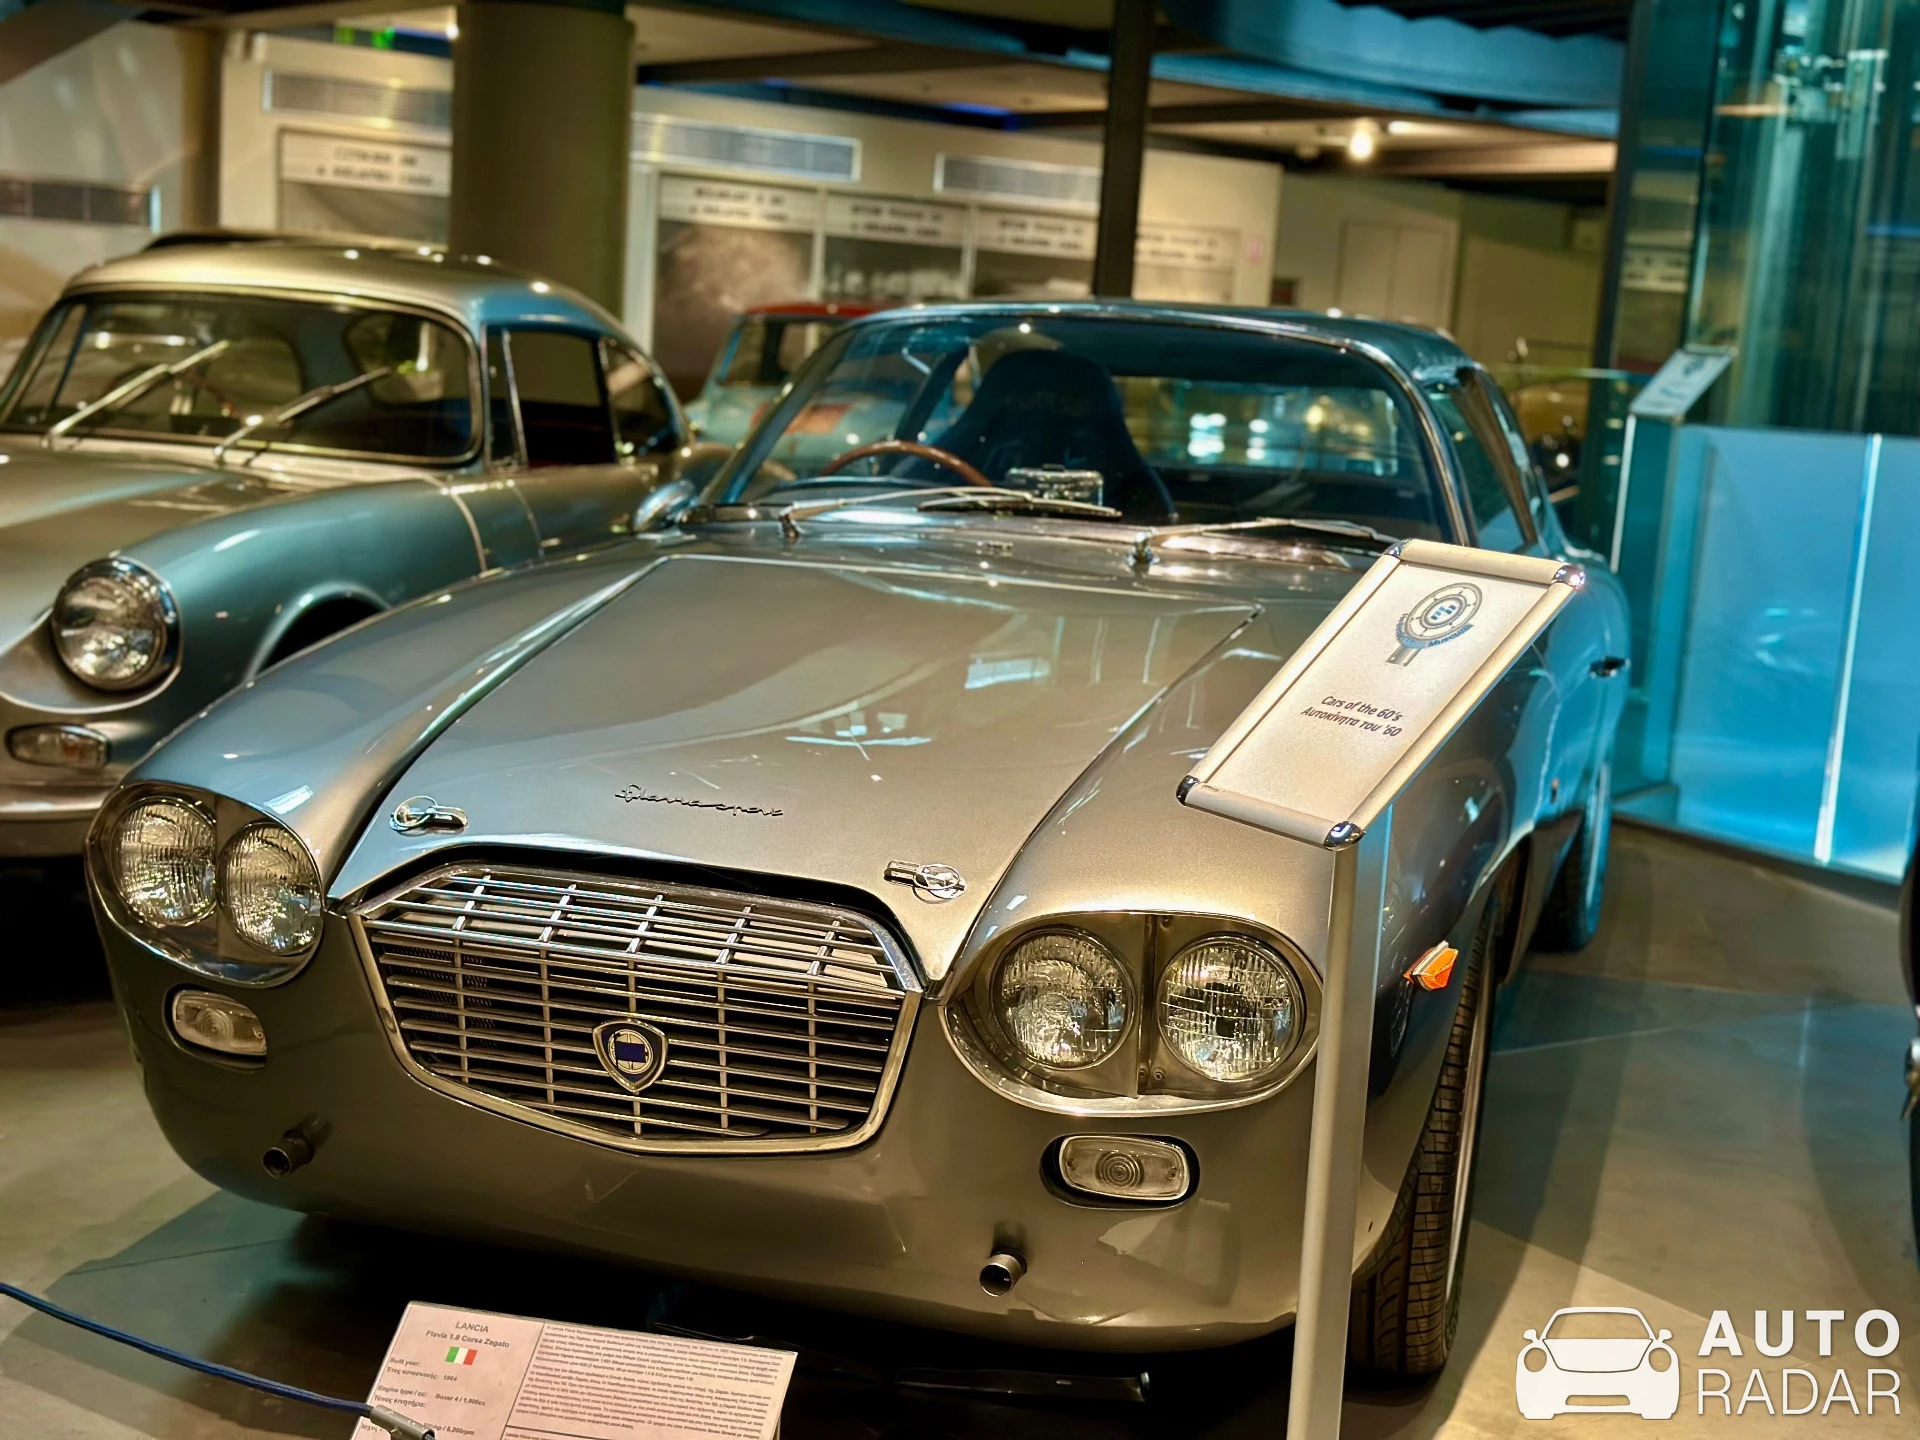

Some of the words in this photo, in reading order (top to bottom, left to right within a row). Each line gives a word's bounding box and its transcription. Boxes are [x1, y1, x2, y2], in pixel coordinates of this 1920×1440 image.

[1321, 695, 1346, 708] Cars
[1344, 701, 1362, 710] of
[1356, 703, 1378, 715] the
[455, 1321, 489, 1333] LANCIA
[426, 1330, 448, 1340] Flavia
[449, 1333, 461, 1341] 1.8
[461, 1335, 483, 1345] Corsa
[484, 1338, 510, 1349] Zagato
[378, 1384, 399, 1393] Engine
